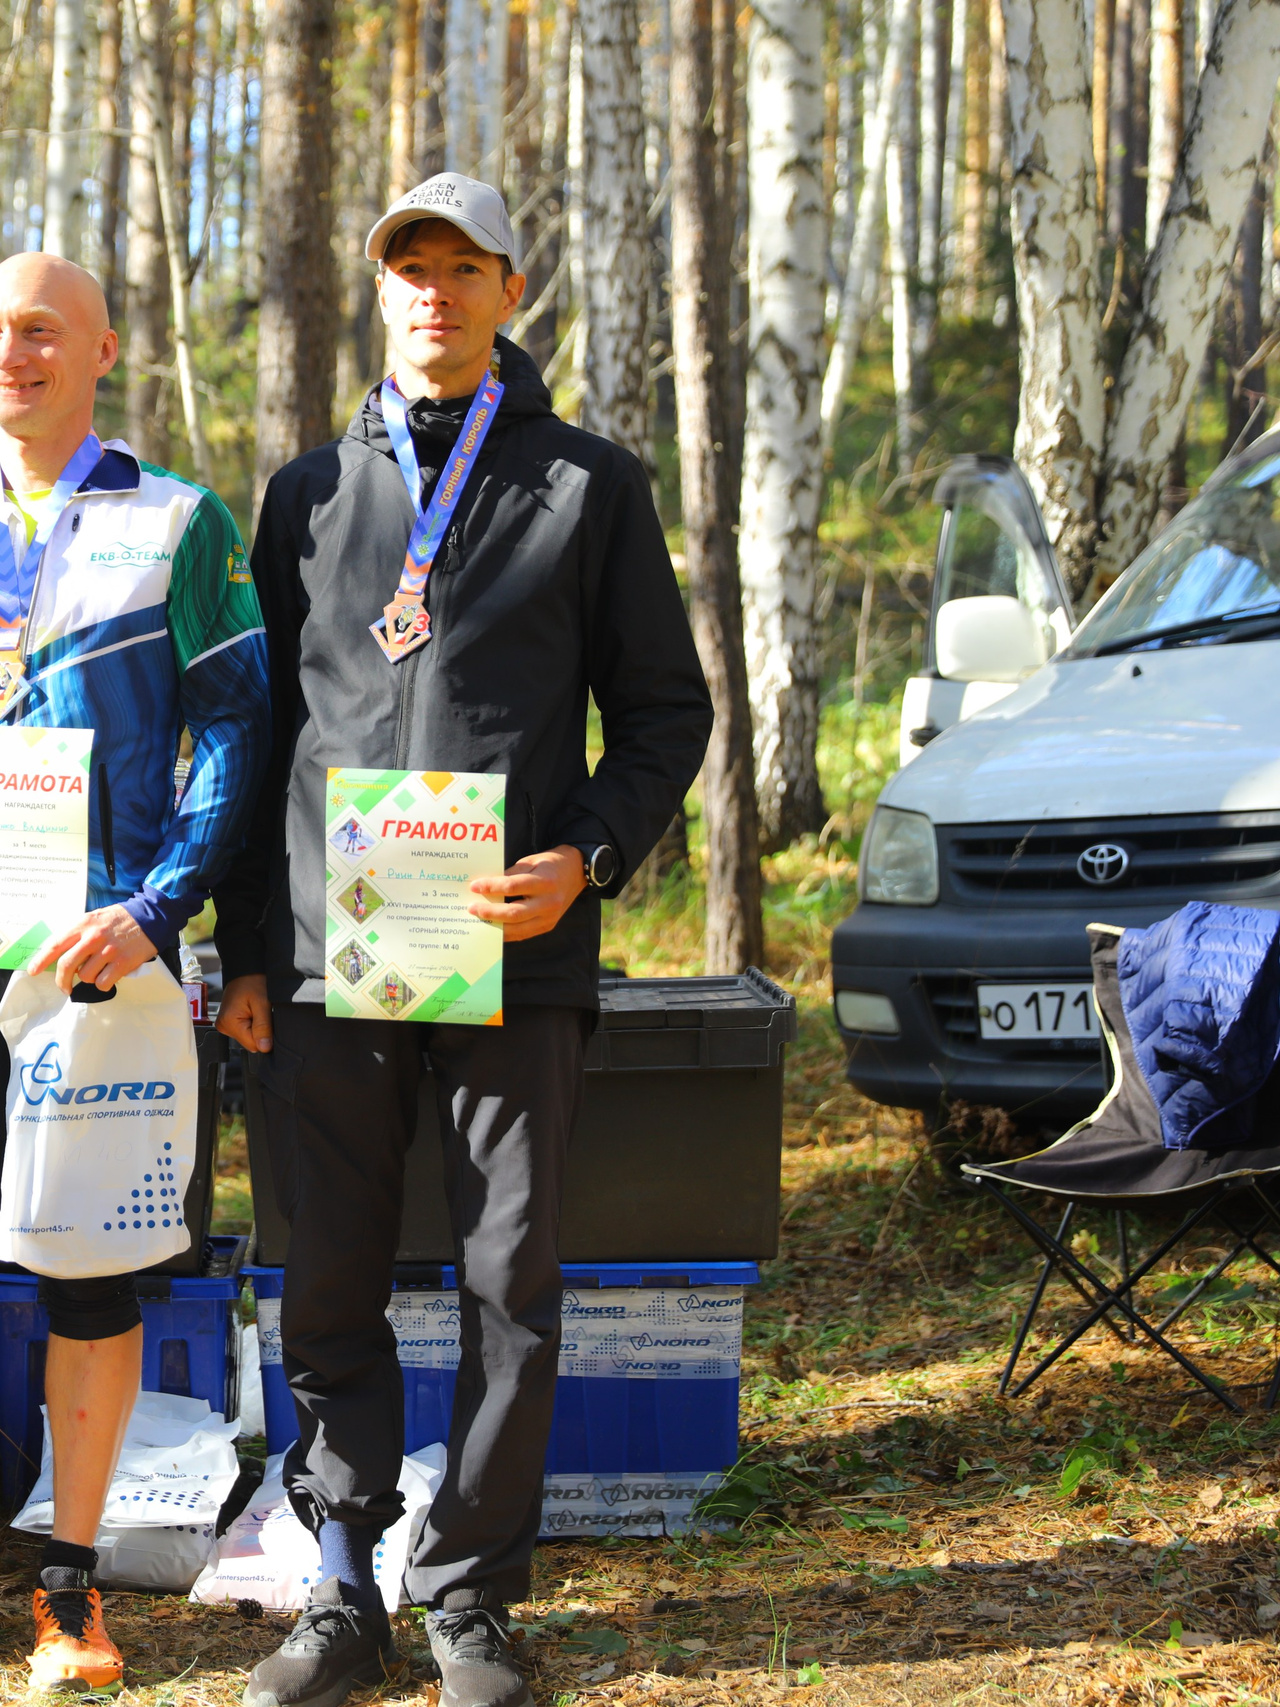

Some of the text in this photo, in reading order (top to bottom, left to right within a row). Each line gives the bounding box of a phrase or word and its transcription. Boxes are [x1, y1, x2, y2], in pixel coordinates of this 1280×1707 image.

[418, 197, 463, 208] TRAILS
[438, 402, 489, 508] ГОРНЫЙ КОРОЛЬ
[412, 613, 431, 633] 3
[4, 801, 56, 810] НАГРАЖДАЕТСЯ
[381, 819, 498, 842] ГРАМОТА
[411, 850, 469, 860] НАГРАЖДАЕТСЯ
[432, 889, 438, 897] 3
[395, 915, 437, 923] спортивному
[47, 1081, 176, 1105] NORD
[86, 1109, 141, 1120] СПОРТИВНАЯ
[143, 1109, 175, 1118] ОДЕЖДА
[700, 1296, 744, 1308] NOR
[571, 1305, 627, 1315] NORD
[399, 1339, 456, 1348] NORD
[652, 1337, 711, 1348] NORD
[624, 1361, 682, 1371] NORD
